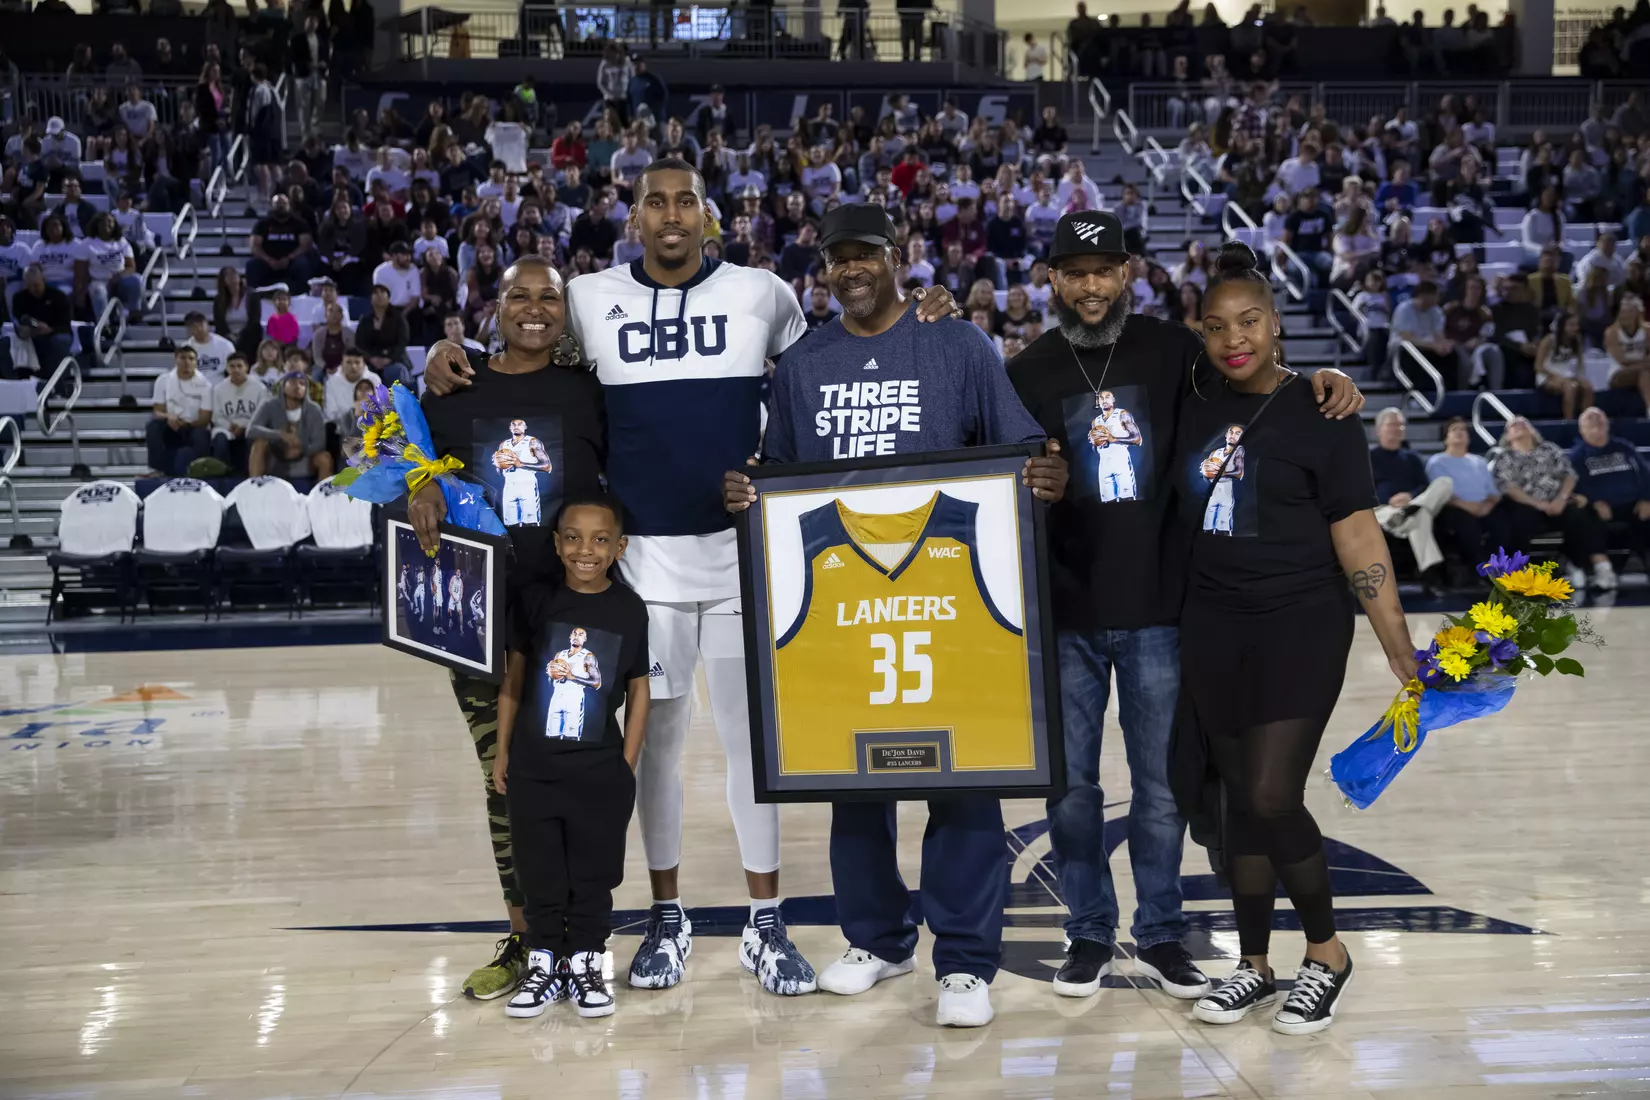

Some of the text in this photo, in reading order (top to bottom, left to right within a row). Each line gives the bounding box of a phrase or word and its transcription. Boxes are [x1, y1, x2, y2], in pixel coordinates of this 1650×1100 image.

[605, 313, 629, 321] adidas
[617, 314, 728, 363] CBU
[820, 379, 920, 408] THREE
[815, 406, 922, 437] STRIPE
[833, 433, 896, 460] LIFE
[822, 561, 845, 570] adidas
[927, 546, 961, 559] WAC
[836, 595, 957, 626] LANCERS
[869, 631, 933, 705] 35
